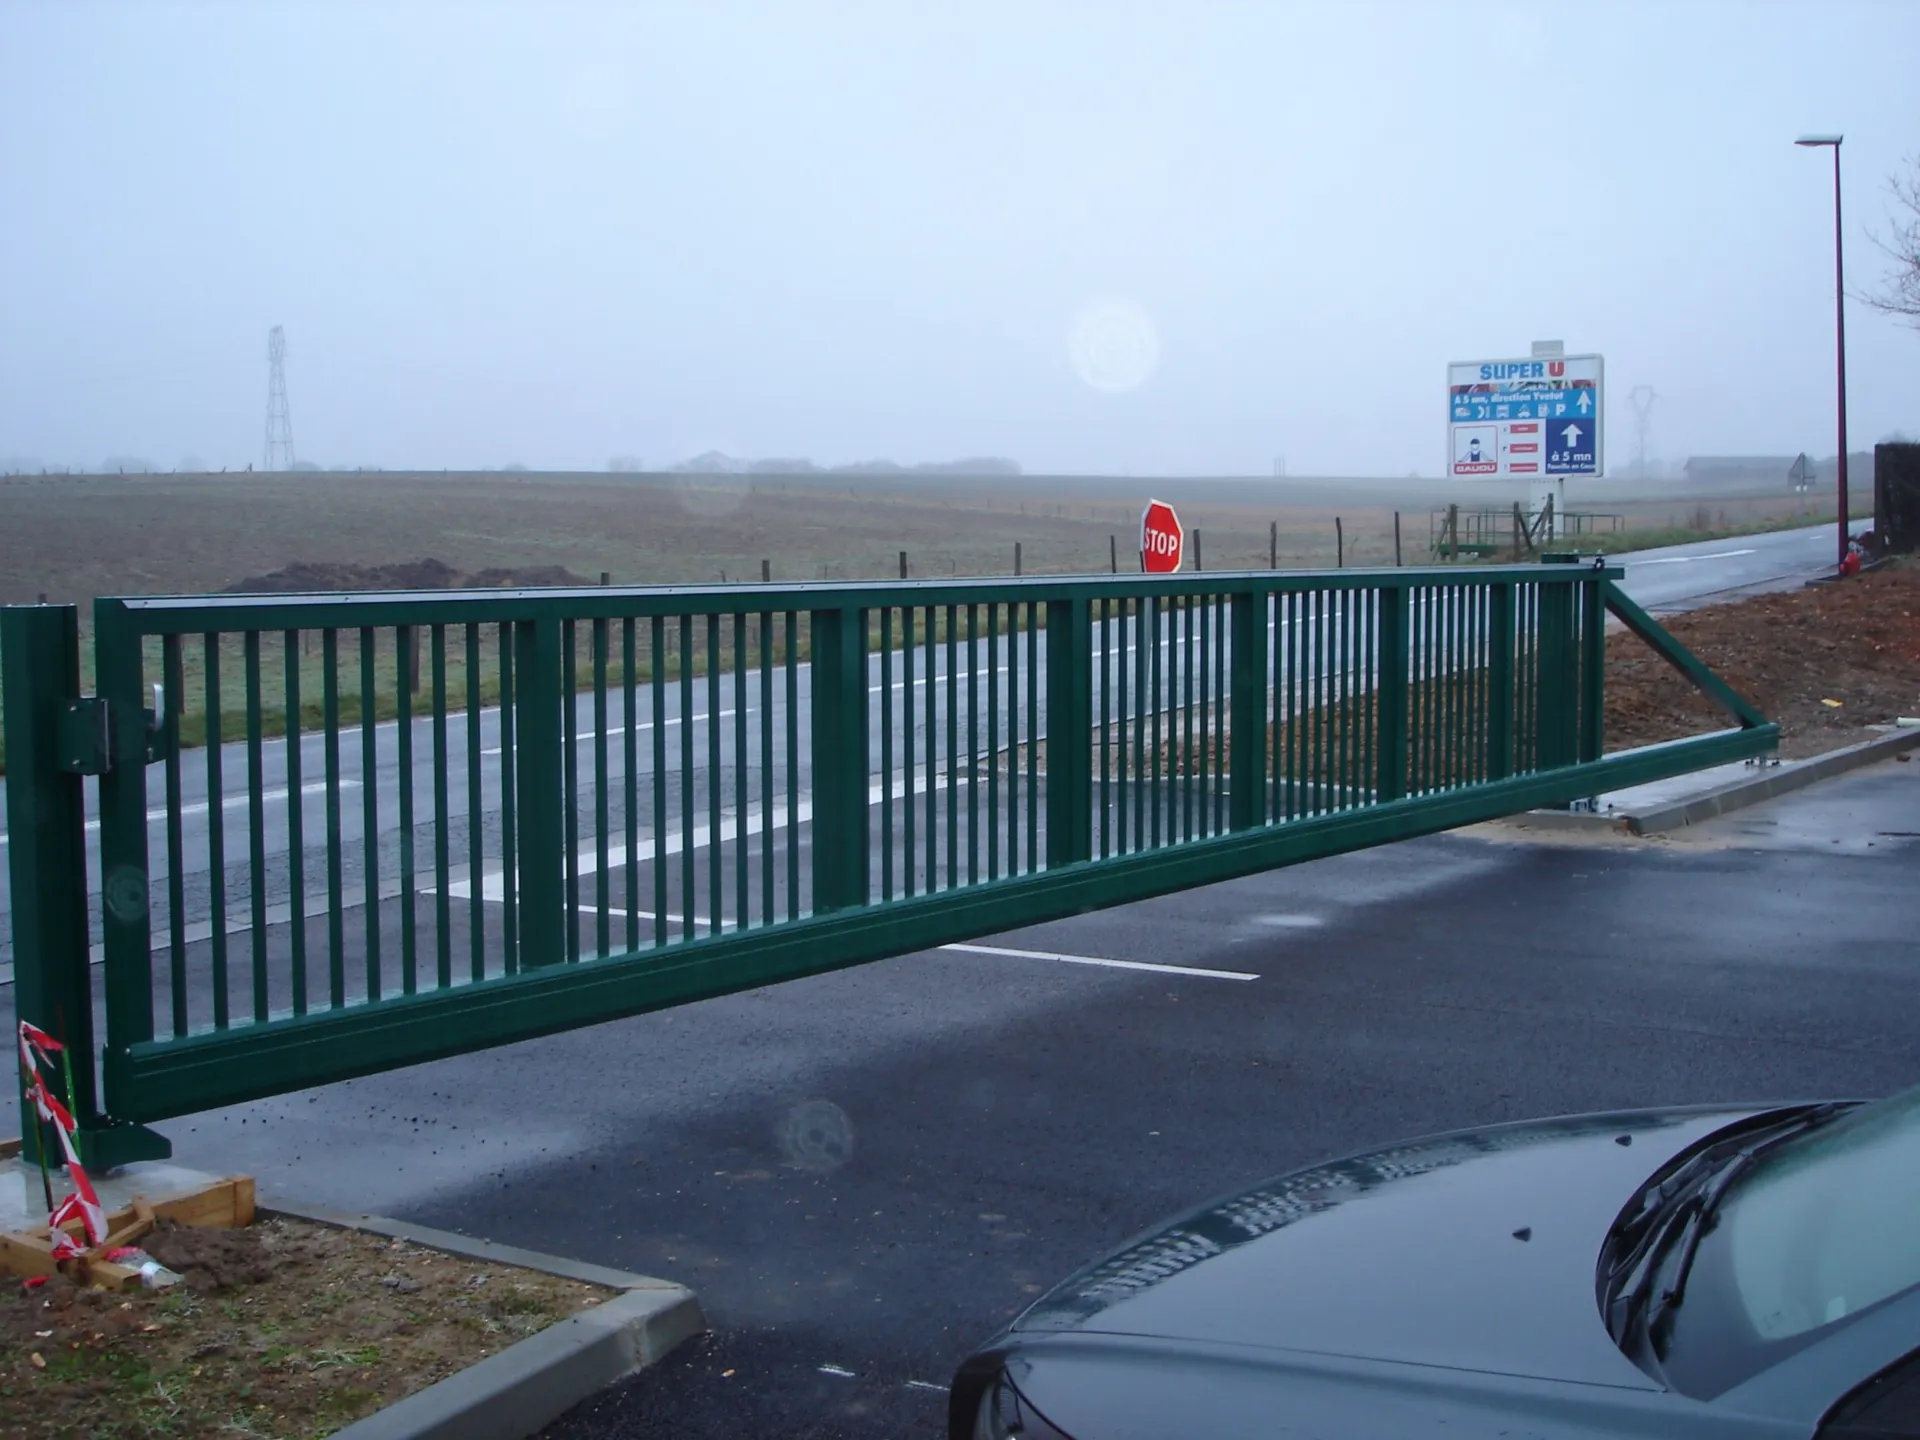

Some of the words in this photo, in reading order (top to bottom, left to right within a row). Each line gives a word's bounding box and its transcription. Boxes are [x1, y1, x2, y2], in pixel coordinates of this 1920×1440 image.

[1480, 361, 1544, 380] SUPER
[1549, 360, 1565, 377] U
[1551, 450, 1560, 461] à
[1563, 451, 1570, 461] 5
[1573, 453, 1592, 461] mn
[1145, 527, 1178, 557] STOP
